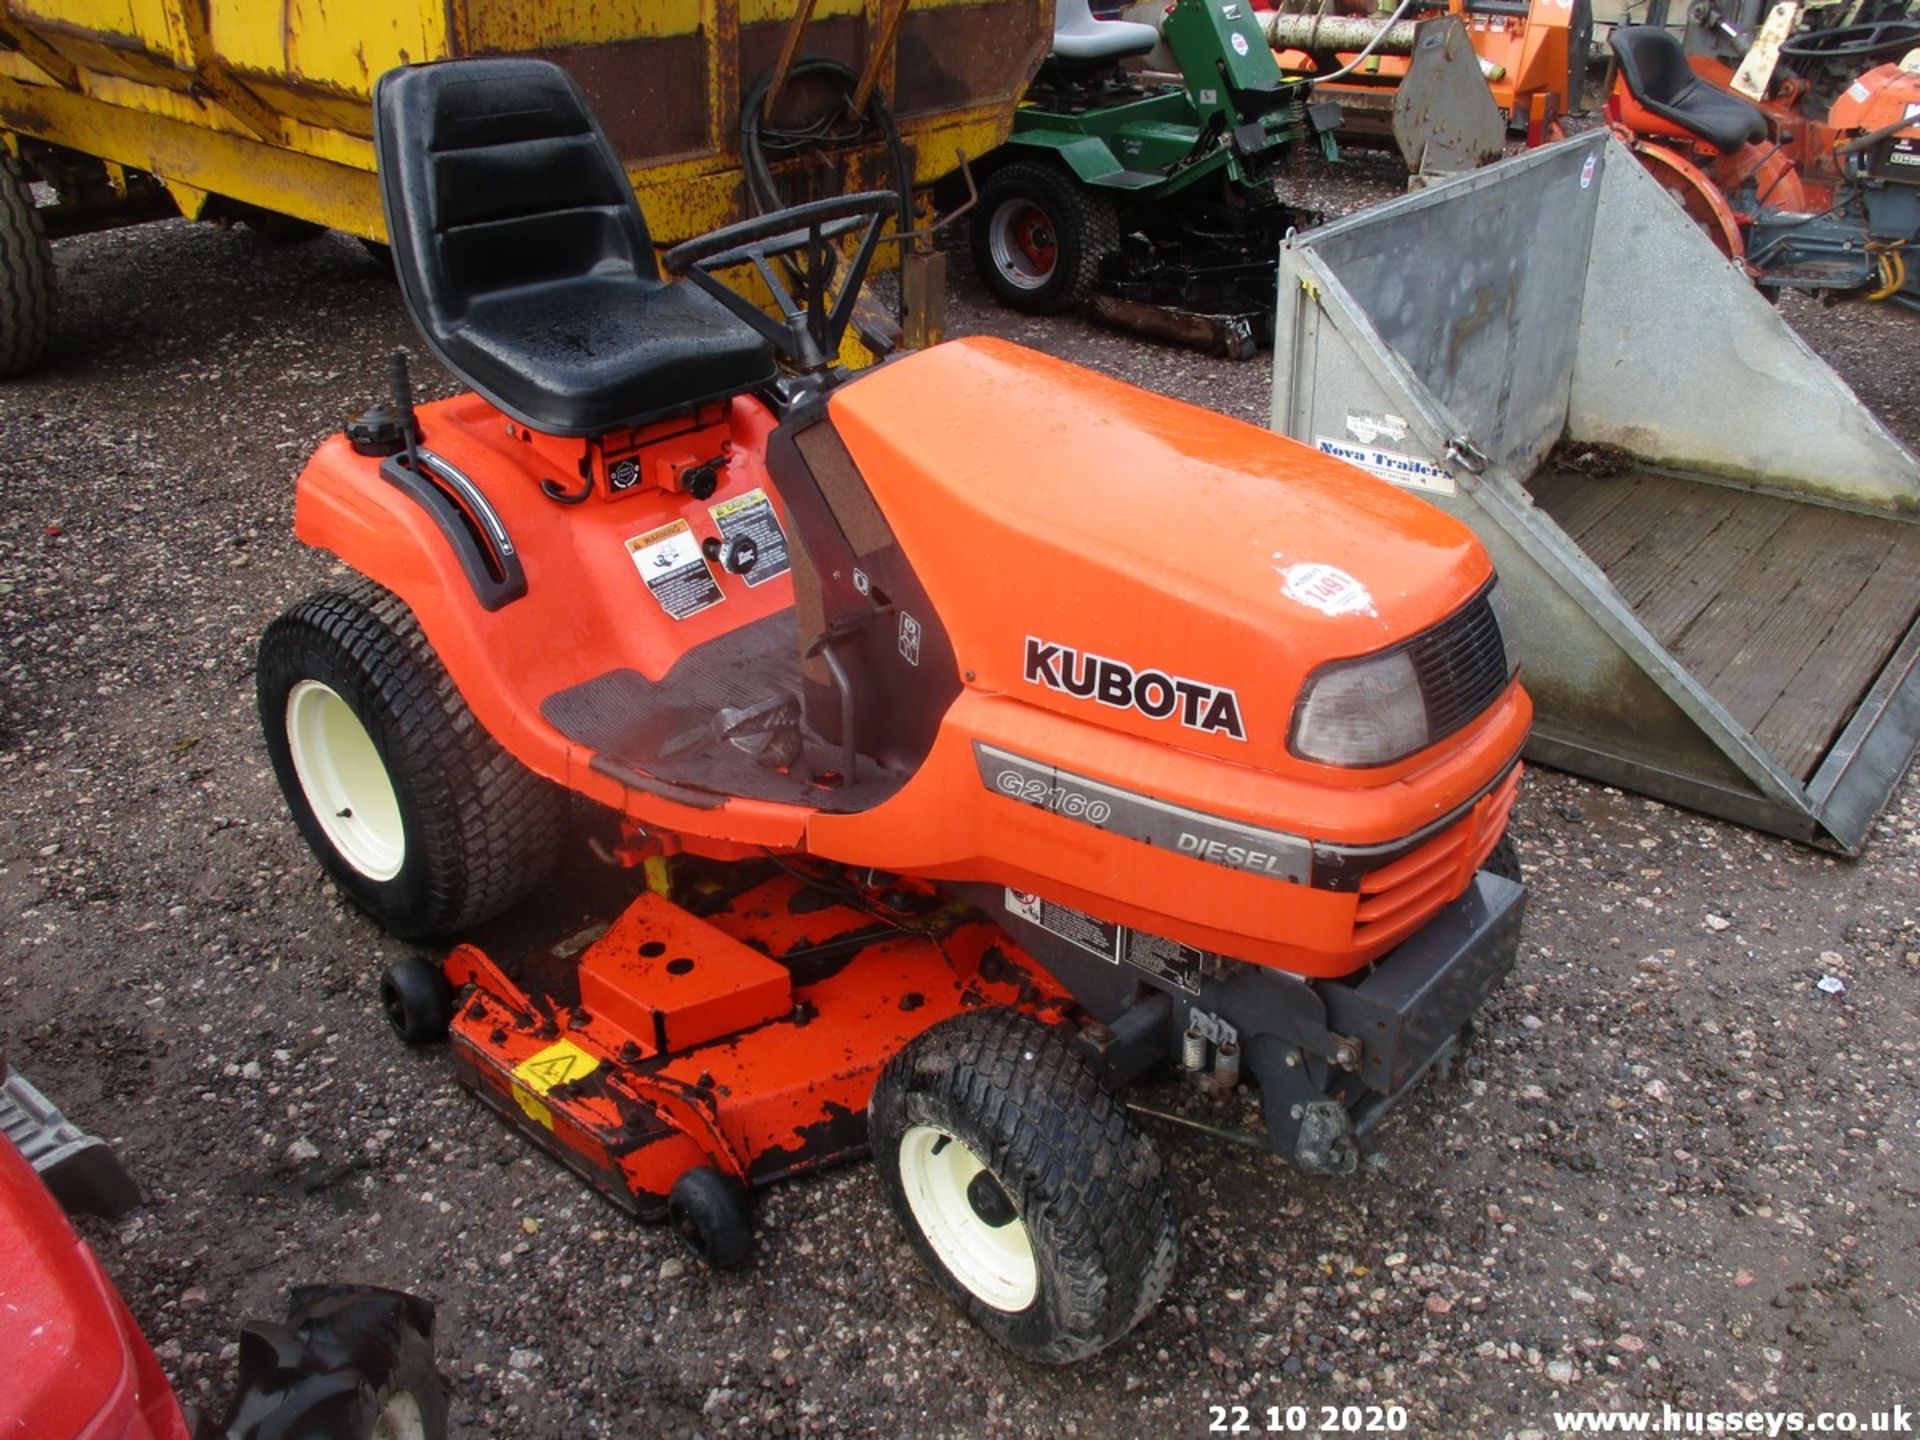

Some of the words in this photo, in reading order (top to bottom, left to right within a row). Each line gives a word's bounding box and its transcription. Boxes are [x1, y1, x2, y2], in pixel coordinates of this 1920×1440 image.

[1319, 441, 1366, 462] Nova
[1372, 453, 1454, 481] Trailers
[1304, 571, 1352, 604] 1491
[1024, 637, 1247, 741] KUBOTA
[996, 770, 1112, 825] G2160
[1175, 832, 1284, 875] DIESEL
